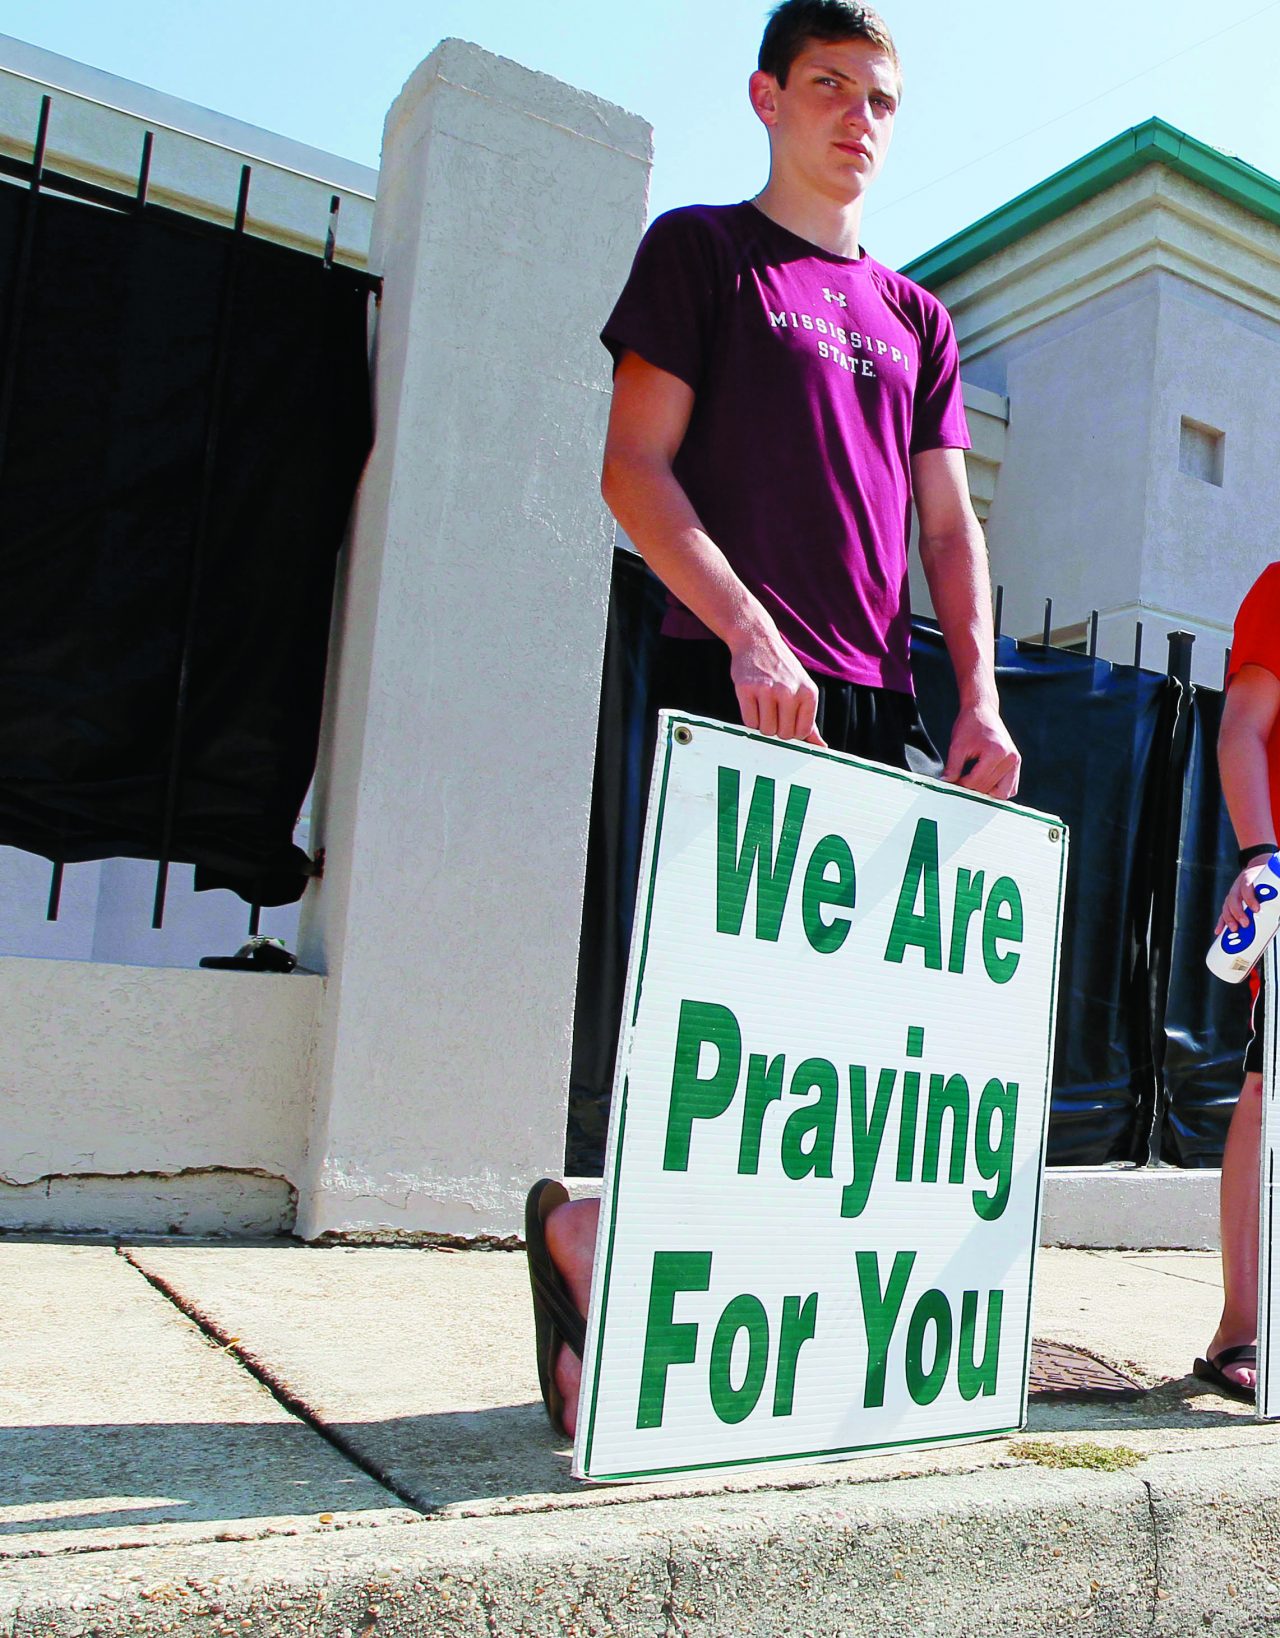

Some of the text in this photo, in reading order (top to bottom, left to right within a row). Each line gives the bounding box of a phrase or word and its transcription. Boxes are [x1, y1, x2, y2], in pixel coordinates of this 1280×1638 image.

[768, 311, 910, 372] MISSISSIPPI
[715, 765, 1025, 985] We Are
[662, 999, 1020, 1221] Praying
[635, 1250, 1005, 1430] For You
